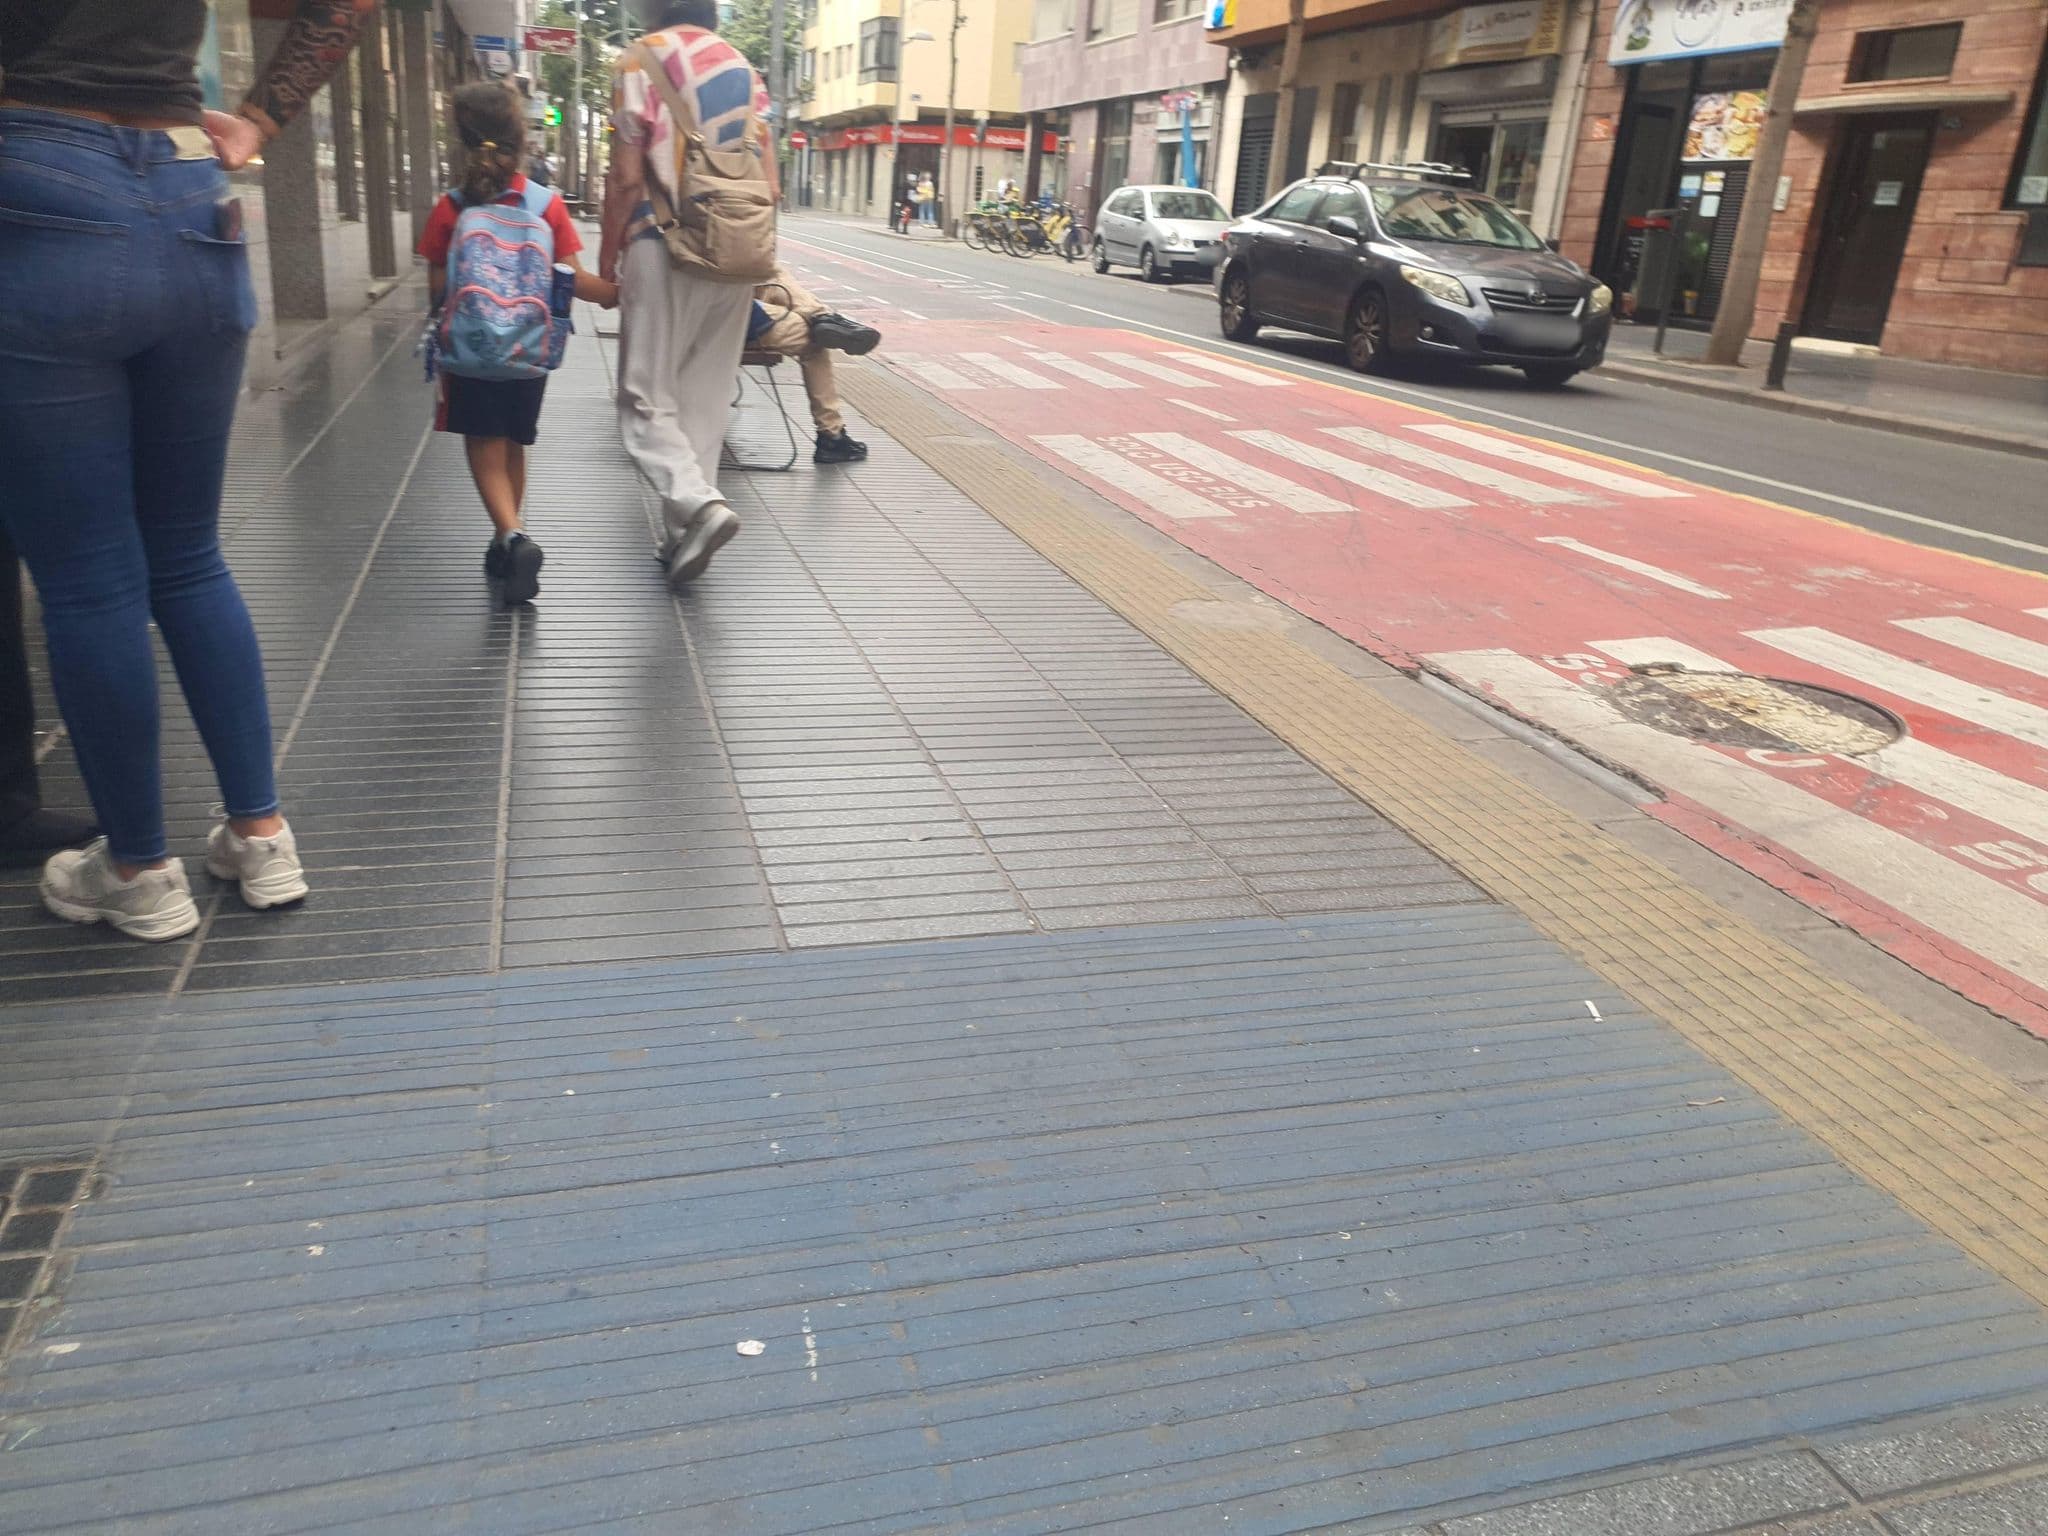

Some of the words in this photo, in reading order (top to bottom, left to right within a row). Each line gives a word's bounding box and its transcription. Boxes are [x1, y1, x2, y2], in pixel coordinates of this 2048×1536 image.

[1095, 436, 1165, 459] SOLO
[1151, 462, 1217, 484] USO
[1198, 486, 1272, 508] BUS
